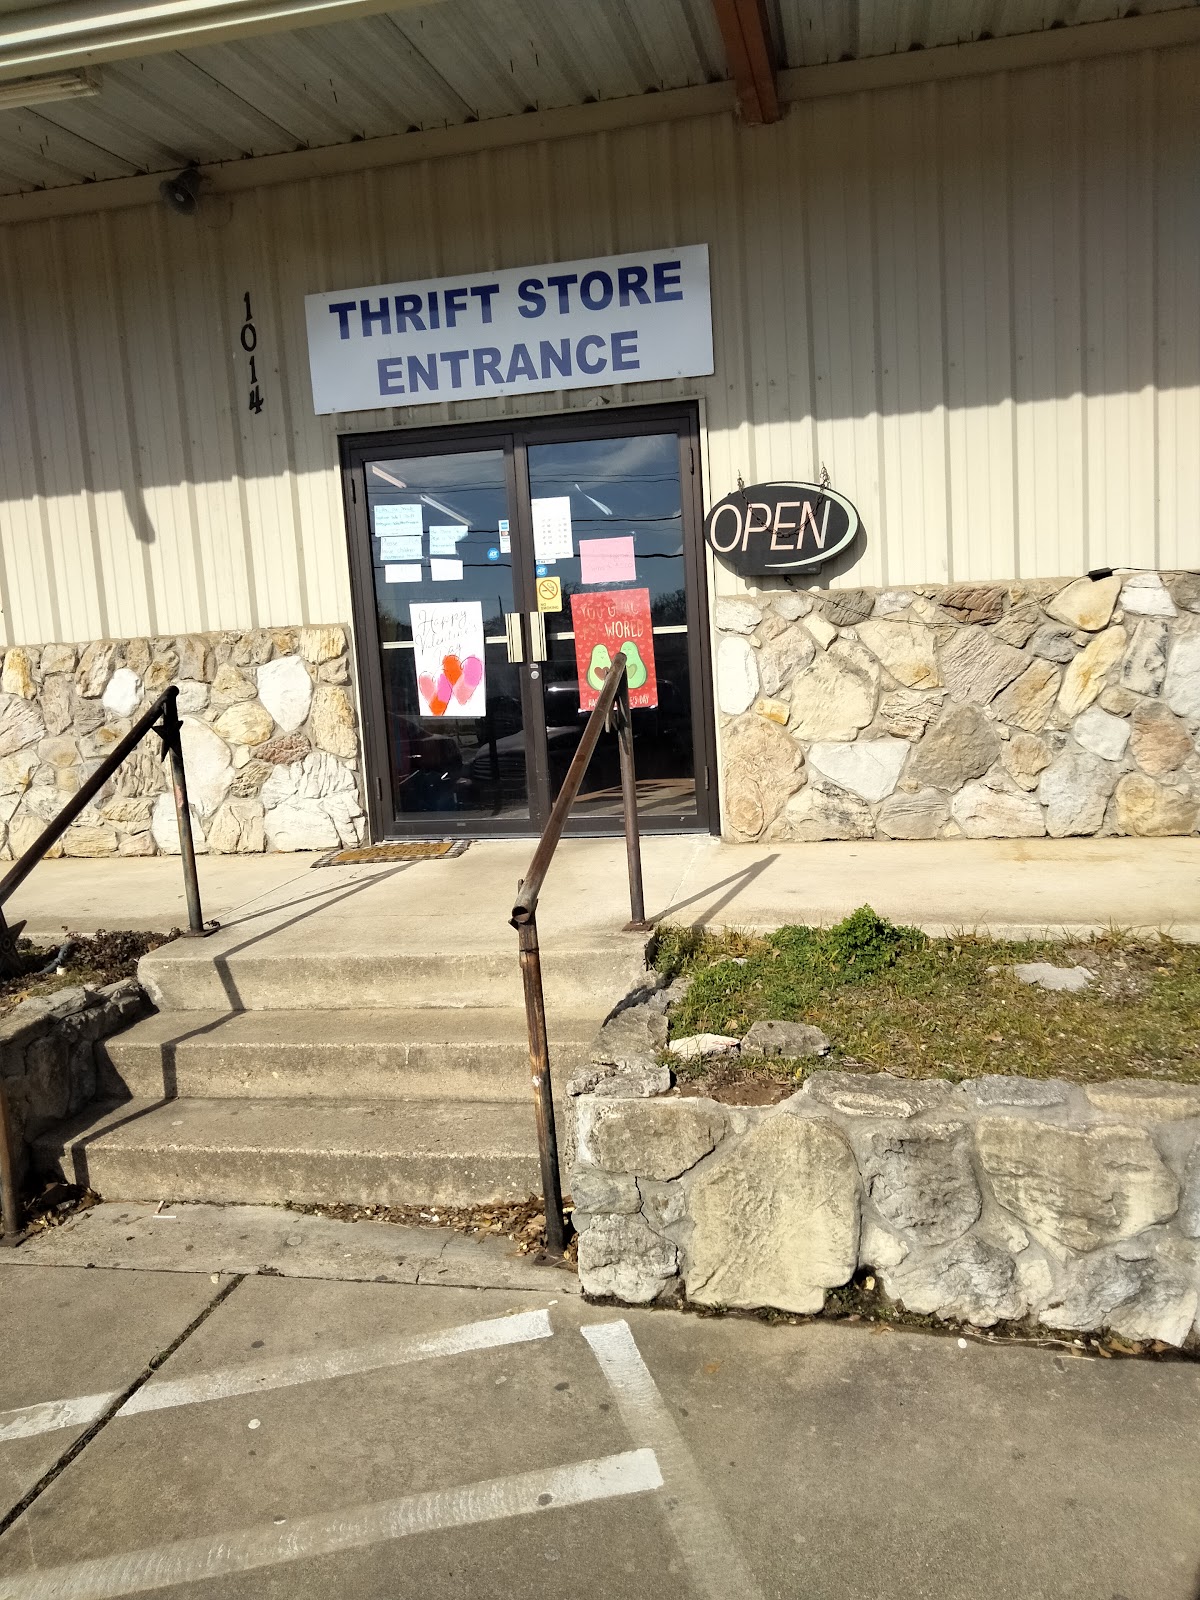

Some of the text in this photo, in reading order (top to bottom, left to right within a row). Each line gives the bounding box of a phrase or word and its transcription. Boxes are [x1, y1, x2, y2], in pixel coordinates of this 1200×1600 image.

[329, 261, 683, 339] THRIFT STORE
[241, 292, 264, 414] 1014
[377, 330, 640, 395] ENTRANCE
[710, 500, 831, 553] OPEN
[418, 608, 467, 635] Happy
[605, 620, 644, 639] WORLD
